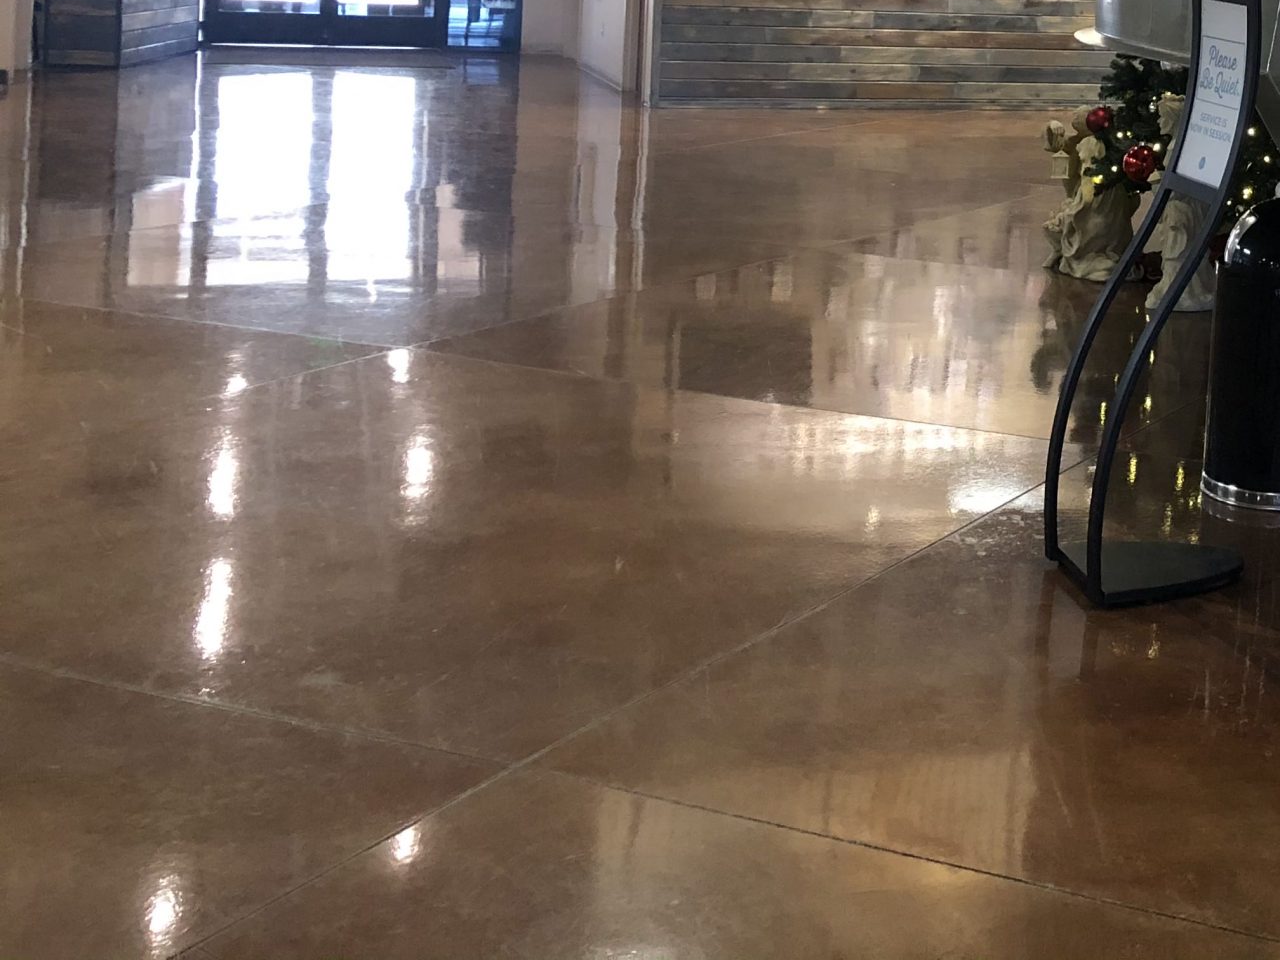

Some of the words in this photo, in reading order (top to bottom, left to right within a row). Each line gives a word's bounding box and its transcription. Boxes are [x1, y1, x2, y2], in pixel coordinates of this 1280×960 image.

[1209, 45, 1238, 71] Please
[1200, 67, 1214, 90] Be
[1200, 112, 1222, 126] SERVICE
